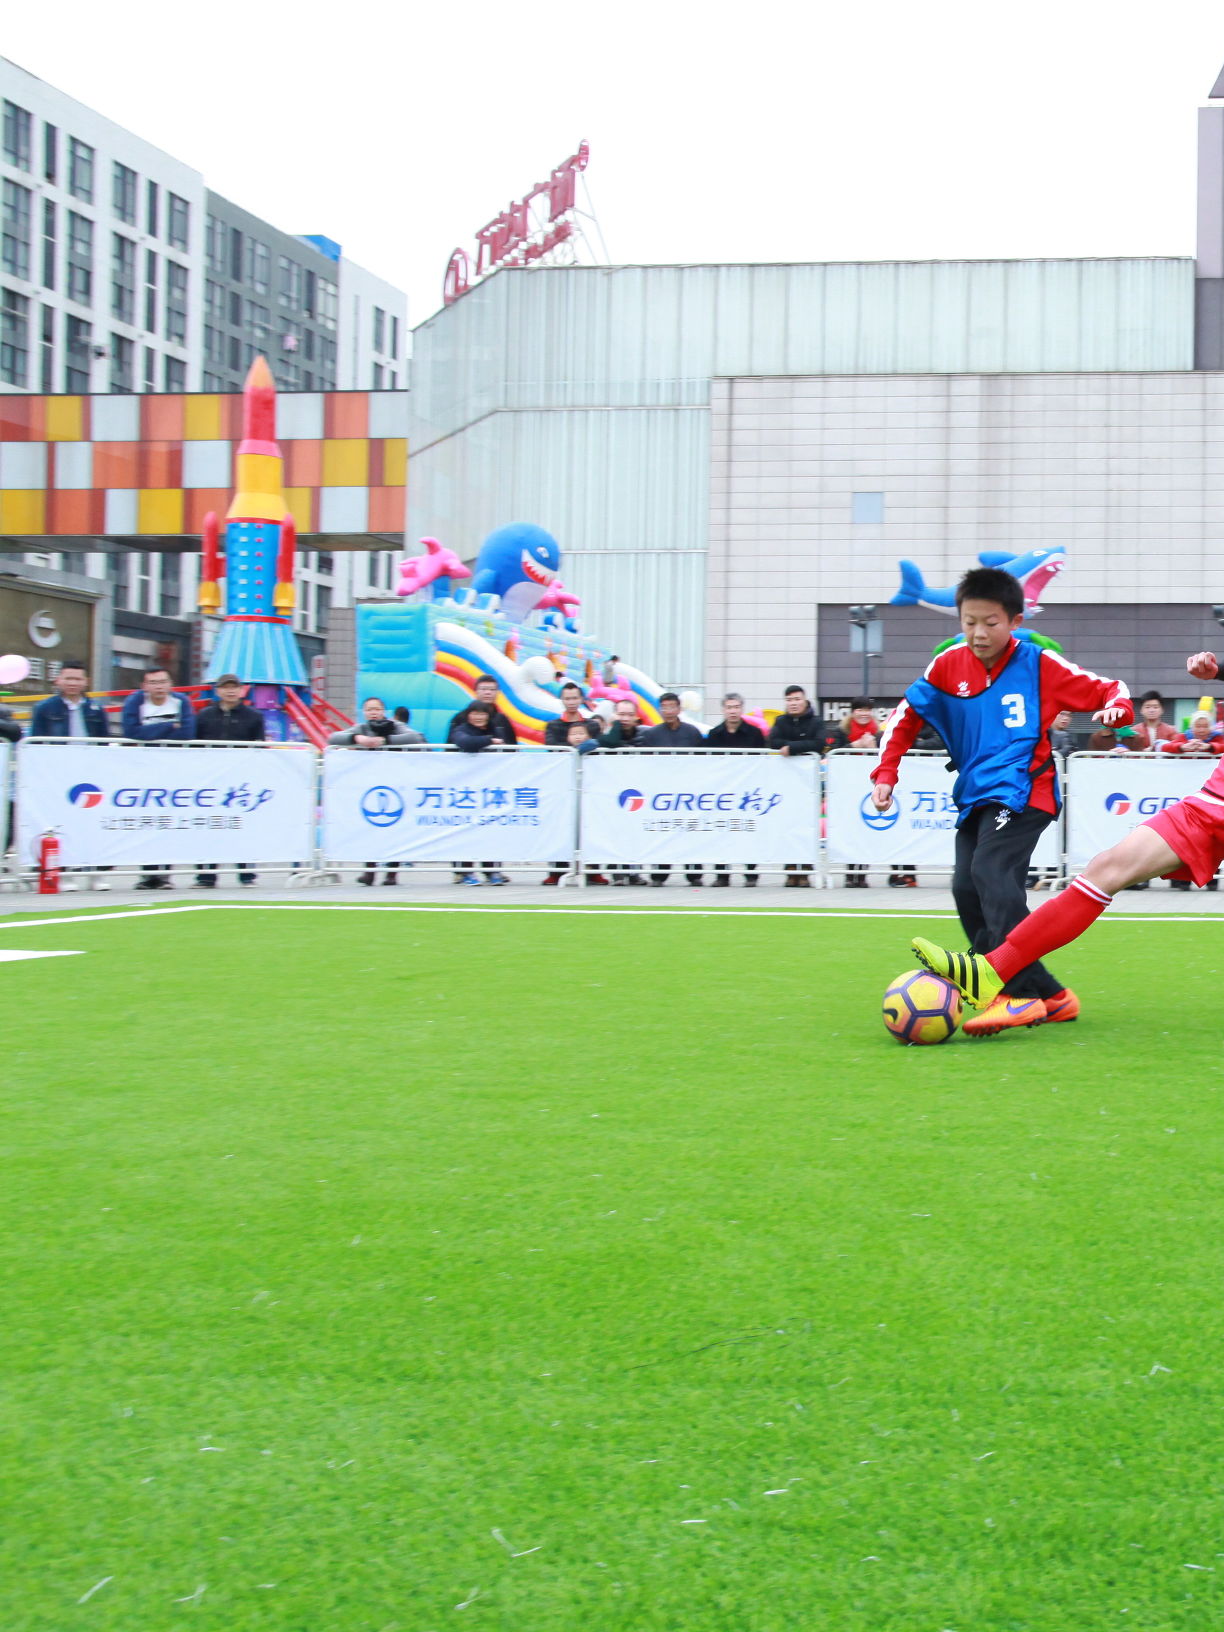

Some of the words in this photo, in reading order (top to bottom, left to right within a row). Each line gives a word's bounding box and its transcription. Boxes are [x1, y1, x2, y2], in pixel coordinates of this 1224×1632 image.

[1001, 693, 1026, 728] 3
[114, 788, 218, 808] GREE
[416, 787, 539, 809] 万达体育
[652, 793, 735, 811] GREE
[911, 791, 959, 813] 万达
[416, 815, 473, 827] WANDA
[477, 815, 539, 827] SPORTS
[911, 819, 954, 830] WAND
